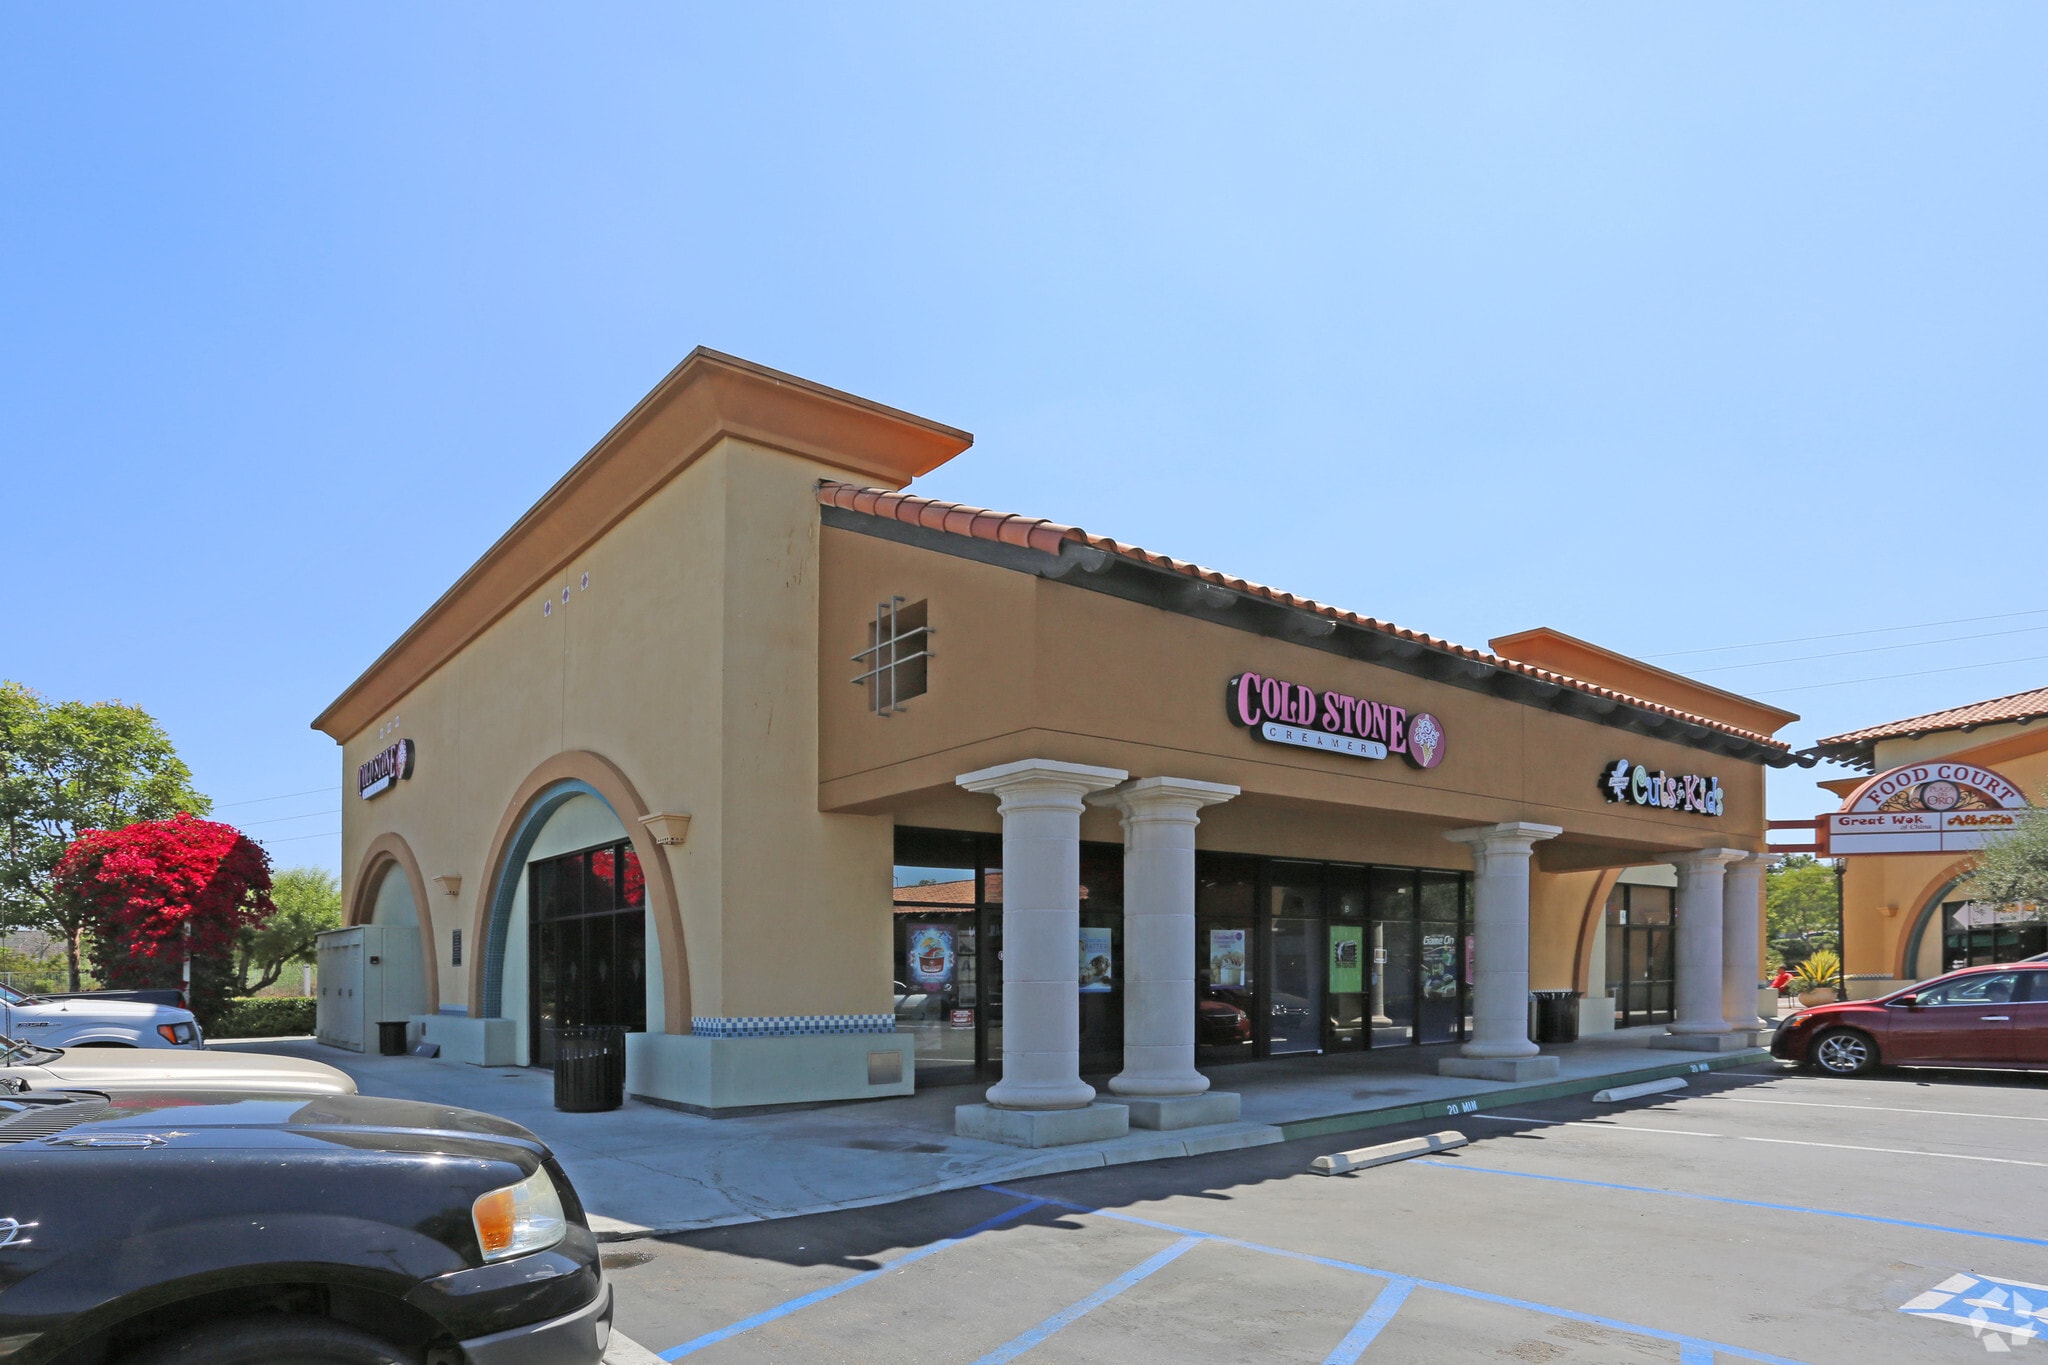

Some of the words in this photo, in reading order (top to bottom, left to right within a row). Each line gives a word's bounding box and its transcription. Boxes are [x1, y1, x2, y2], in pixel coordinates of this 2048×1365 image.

[1238, 672, 1316, 726] COLD
[1322, 691, 1406, 753] STONE
[1632, 765, 1677, 808] Cuts
[1683, 774, 1724, 816] Kids
[1866, 767, 1929, 806] FOOD
[1937, 765, 2015, 801] COURT
[1926, 795, 1955, 806] ORO
[1838, 815, 1886, 826] Great
[1892, 814, 1924, 825] Wok
[1423, 935, 1444, 946] Game
[1443, 935, 1455, 945] On
[1446, 1104, 1459, 1115] 20
[1461, 1100, 1478, 1113] MIN
